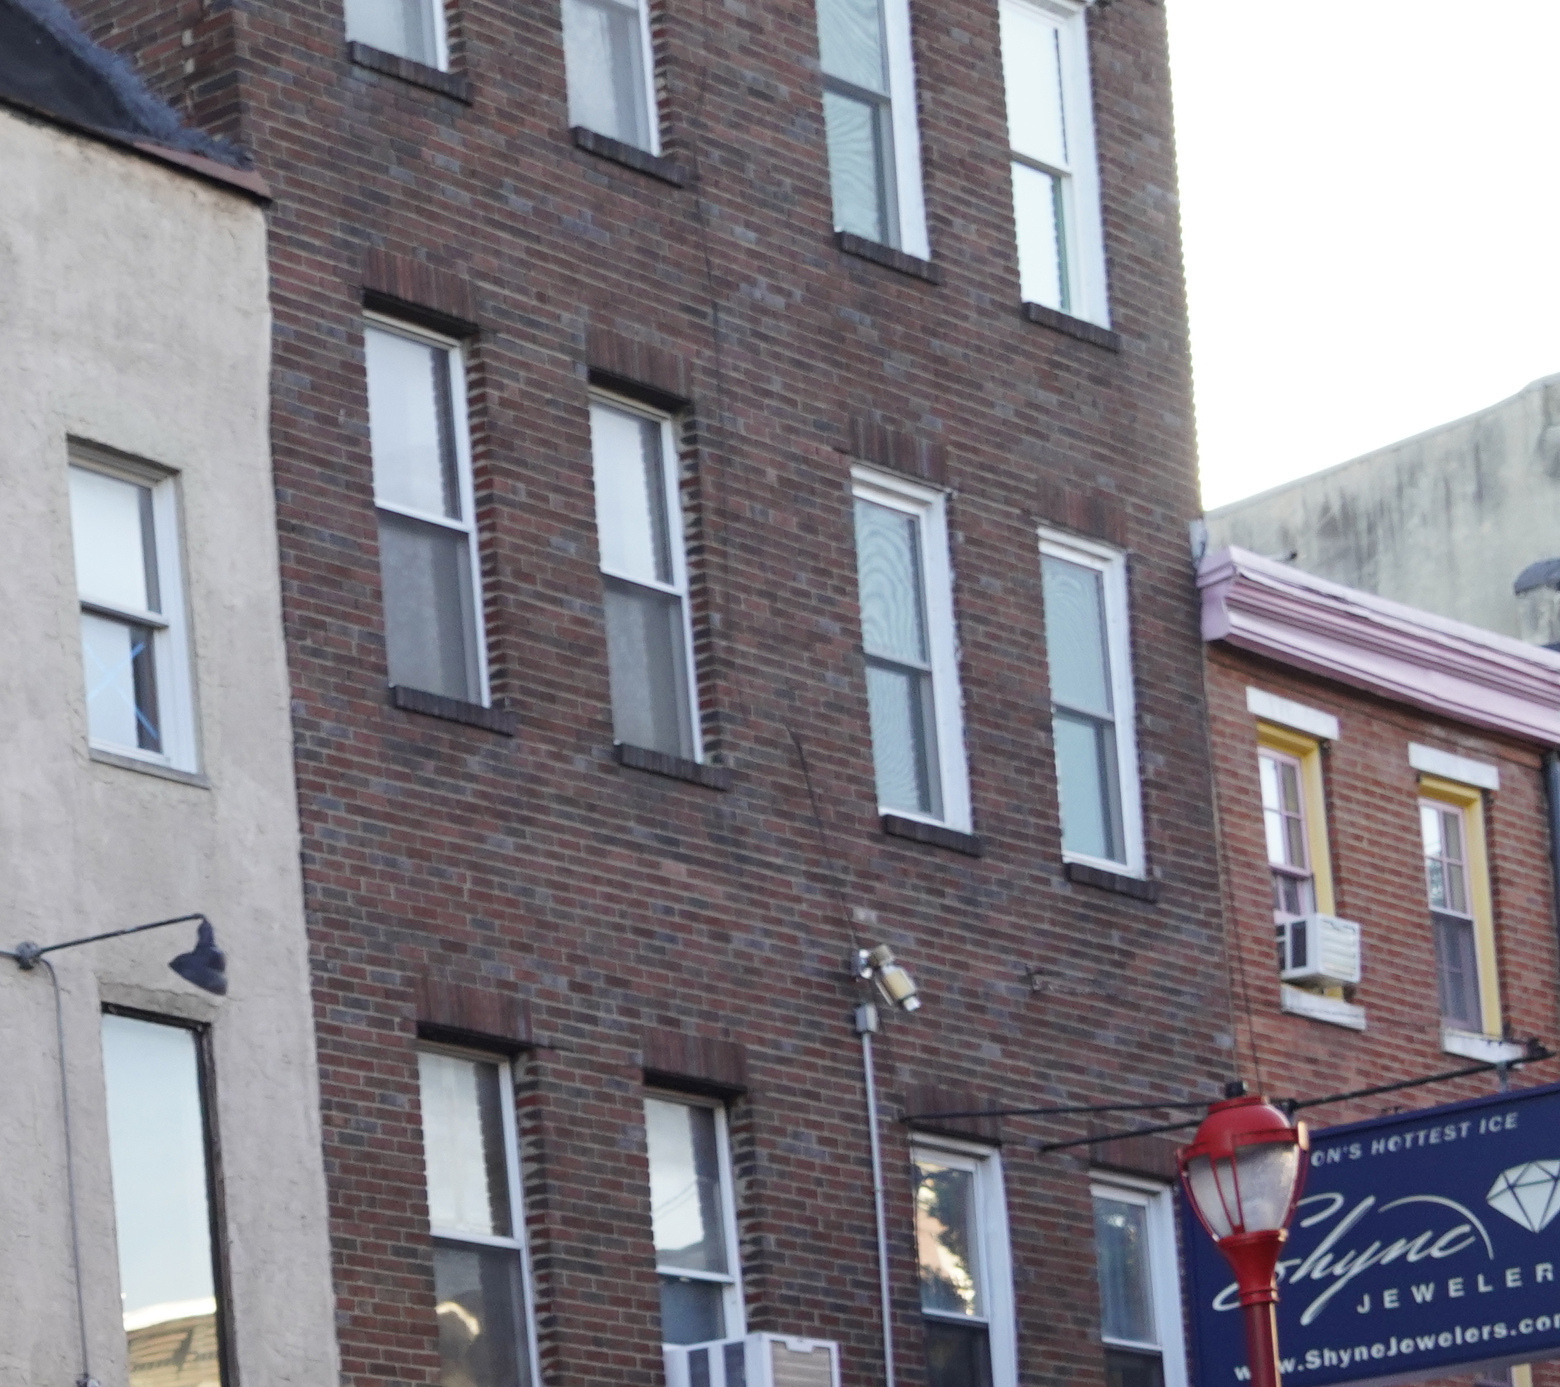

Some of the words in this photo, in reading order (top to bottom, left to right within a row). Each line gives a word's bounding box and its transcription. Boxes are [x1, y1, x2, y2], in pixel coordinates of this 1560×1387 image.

[1370, 1120, 1472, 1156] HOTTEST
[1479, 1111, 1519, 1136] ICE
[1234, 1310, 1560, 1381] ww.ShyneJewelers.co
